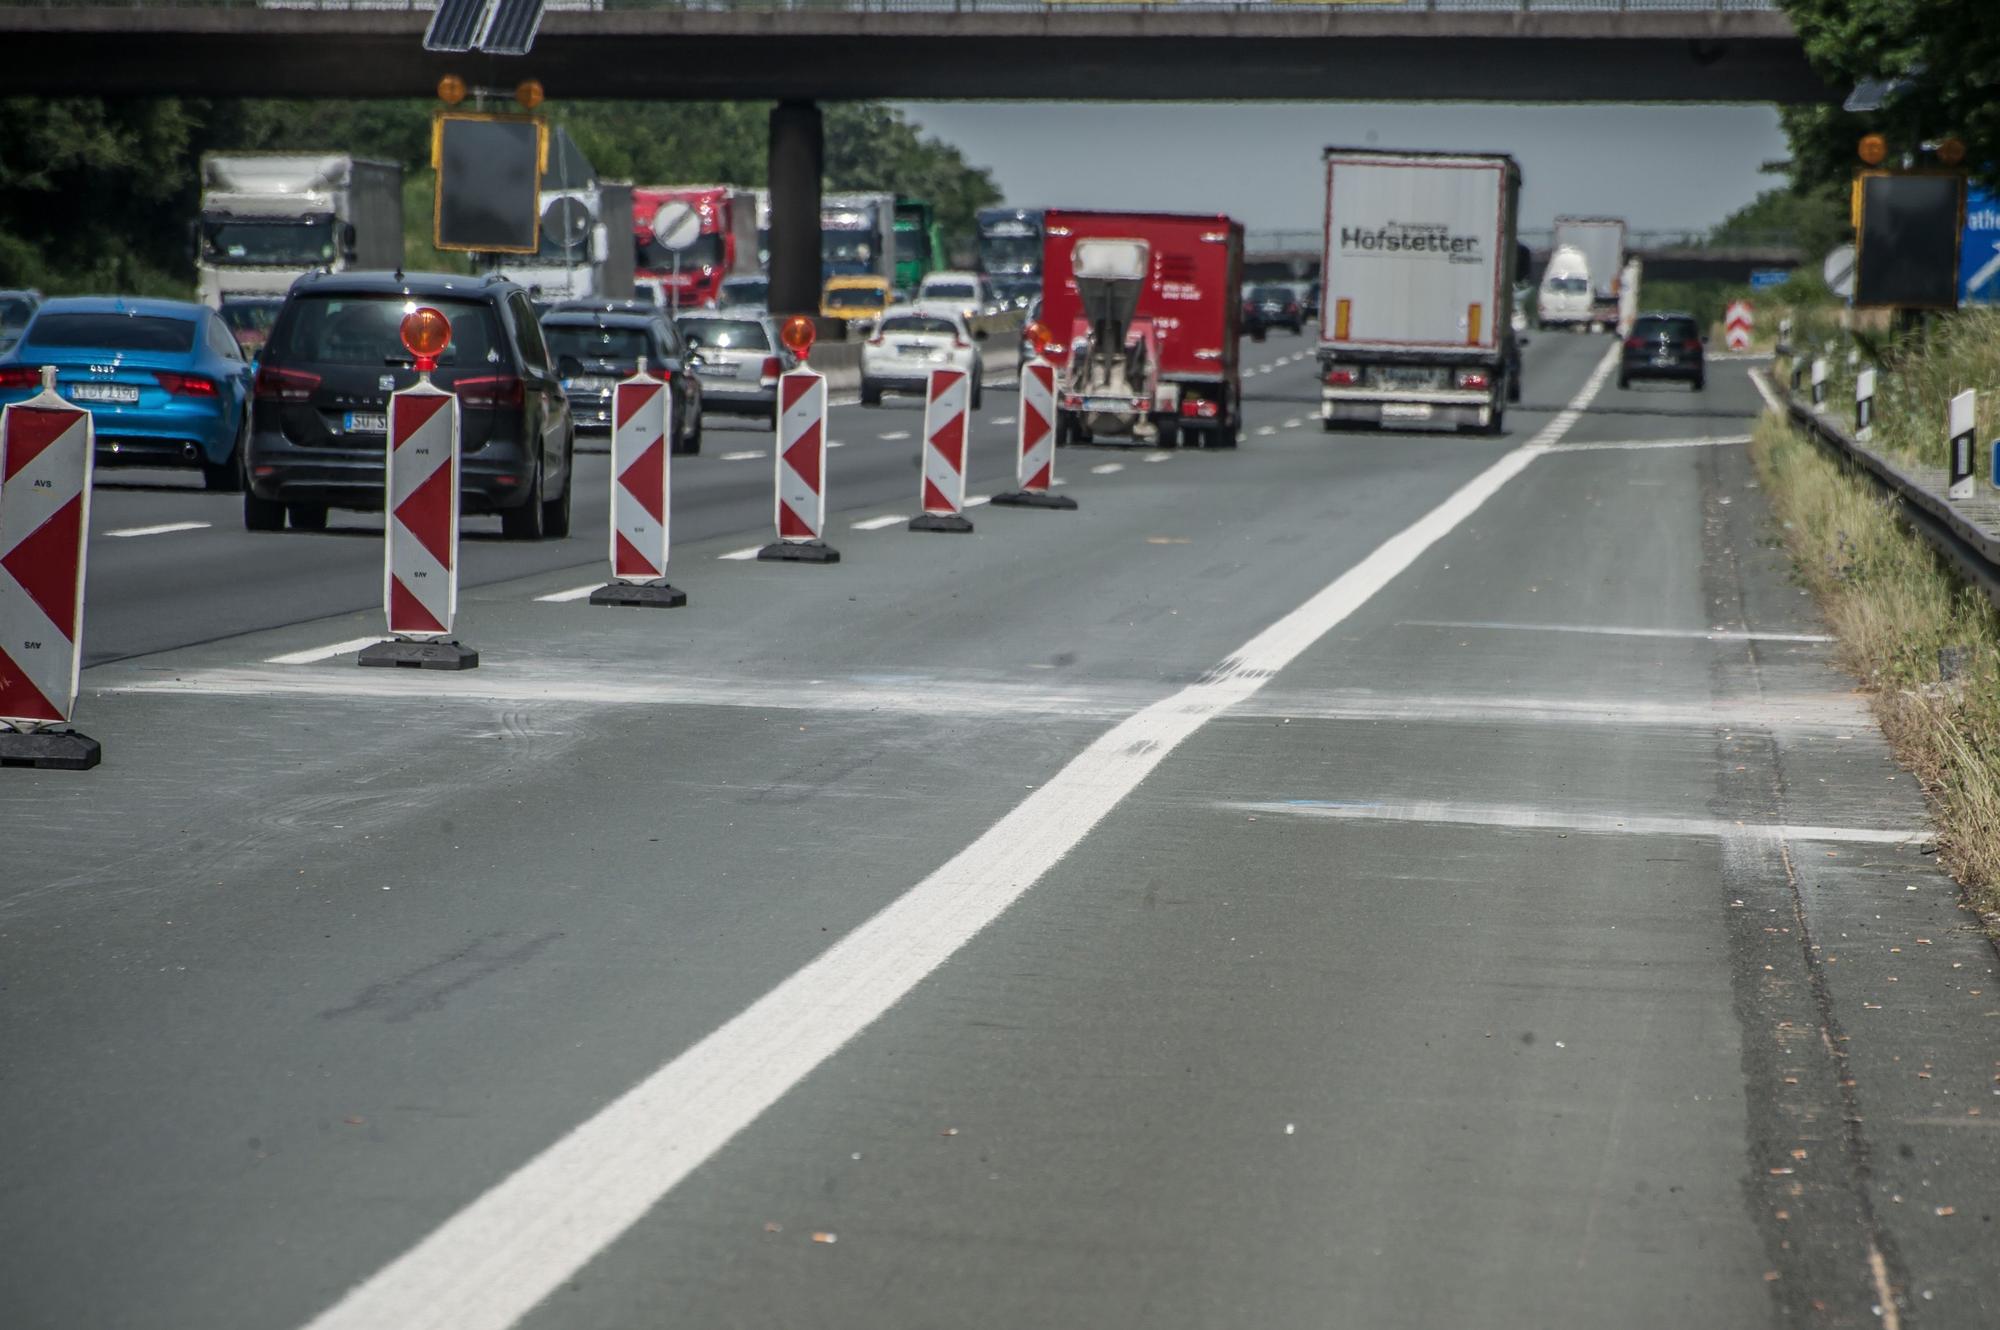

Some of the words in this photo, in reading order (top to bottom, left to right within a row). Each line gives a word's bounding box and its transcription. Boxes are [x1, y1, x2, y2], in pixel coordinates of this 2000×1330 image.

[353, 415, 370, 429] SU
[34, 479, 52, 488] AVS
[24, 640, 42, 649] AVS
